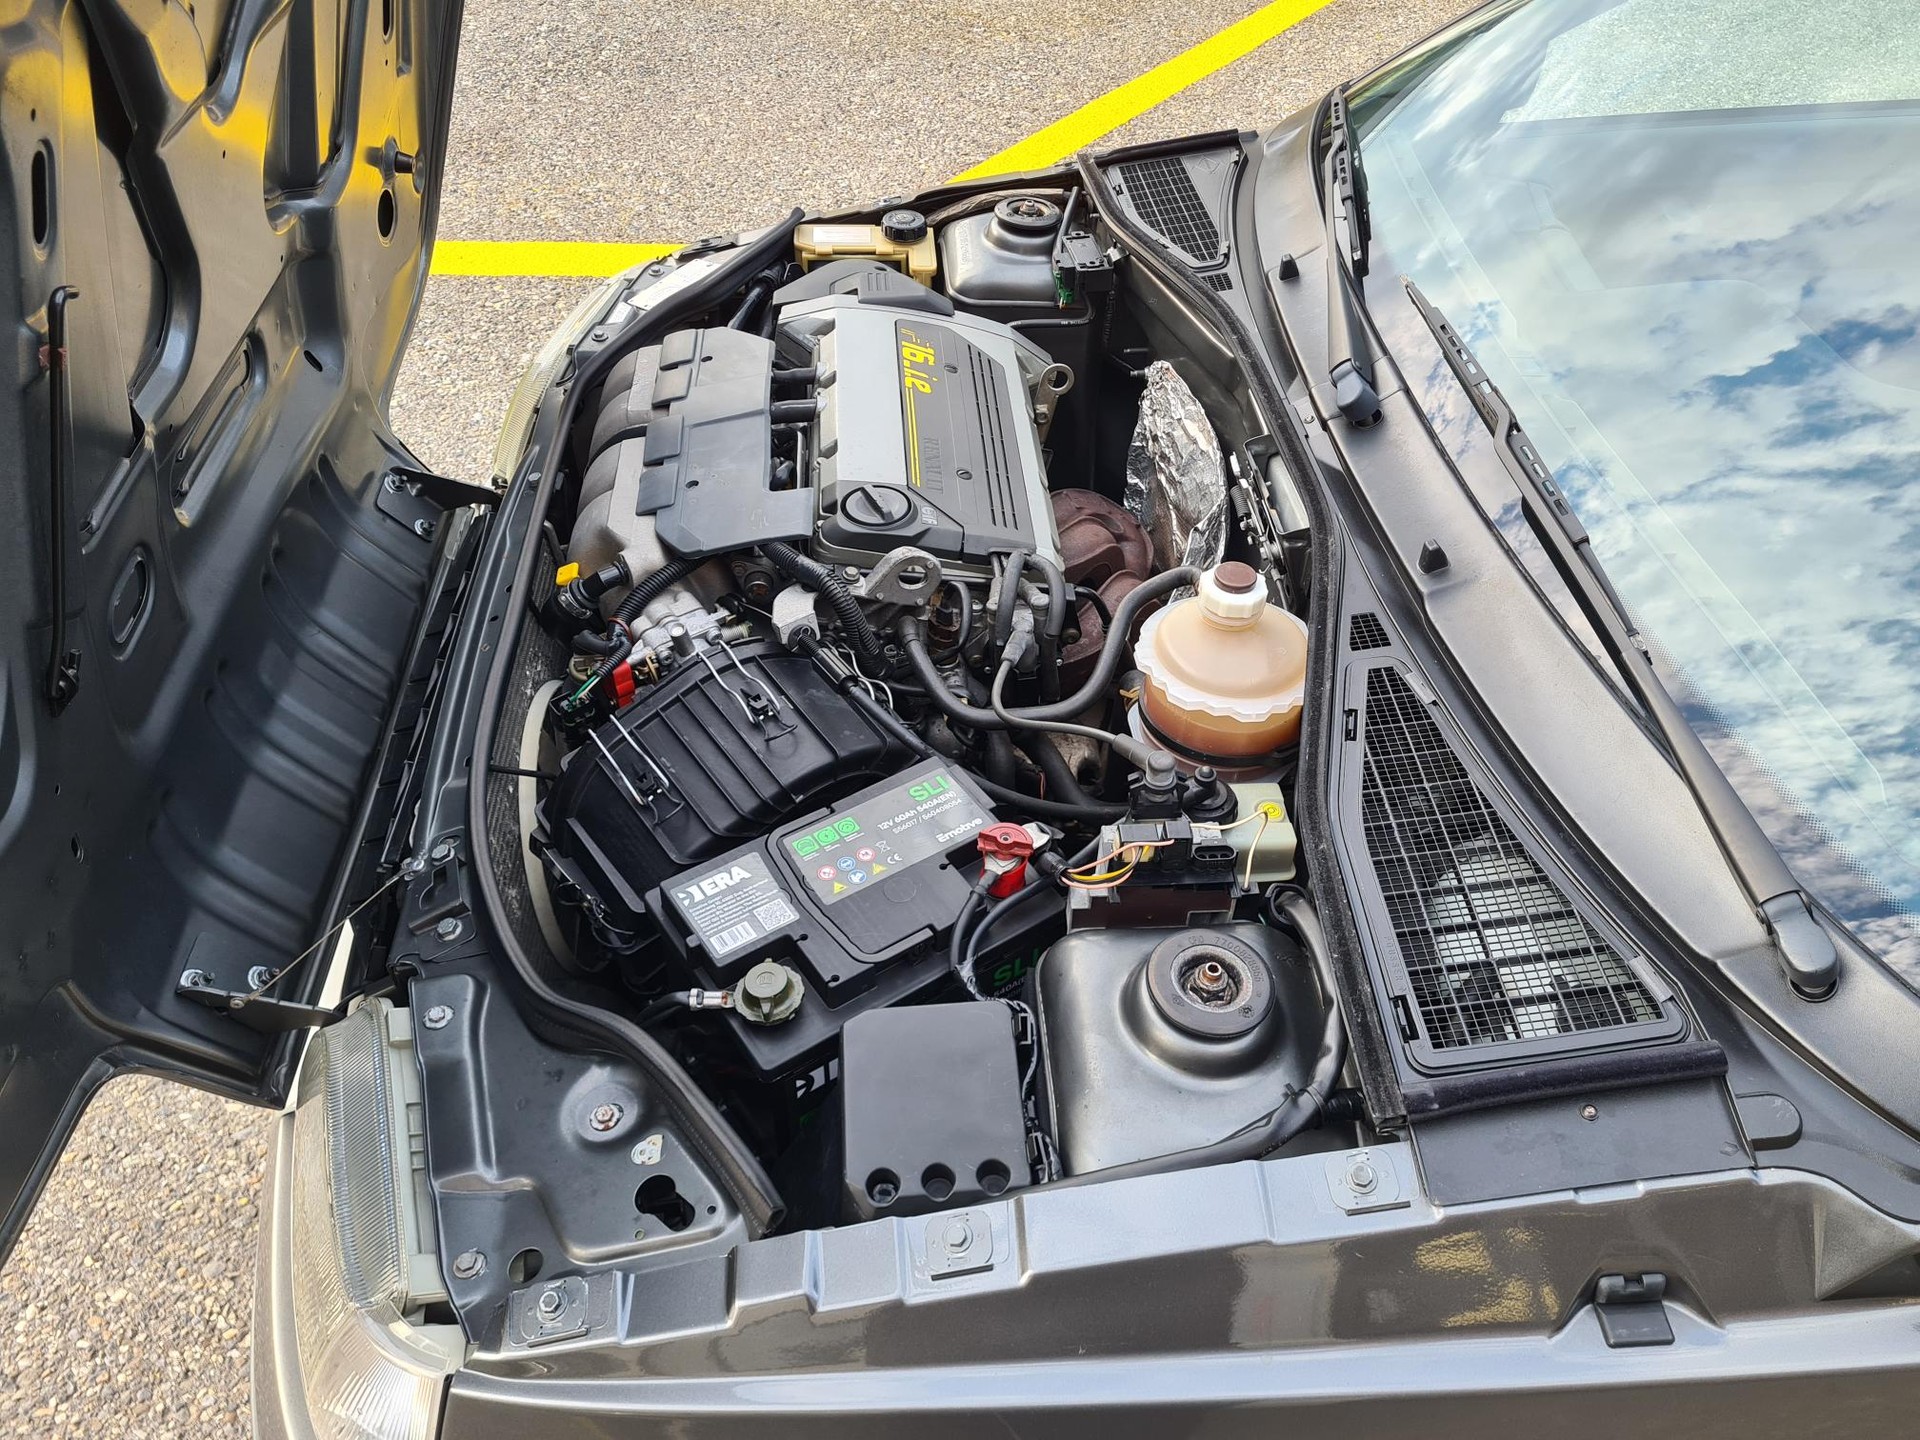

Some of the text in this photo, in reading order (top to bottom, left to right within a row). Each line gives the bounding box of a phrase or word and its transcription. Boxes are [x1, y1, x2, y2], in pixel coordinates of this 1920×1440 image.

[908, 775, 951, 801] SLI
[877, 790, 957, 830] 12V 60Ah 540A(EN)
[936, 817, 983, 843] Emotive
